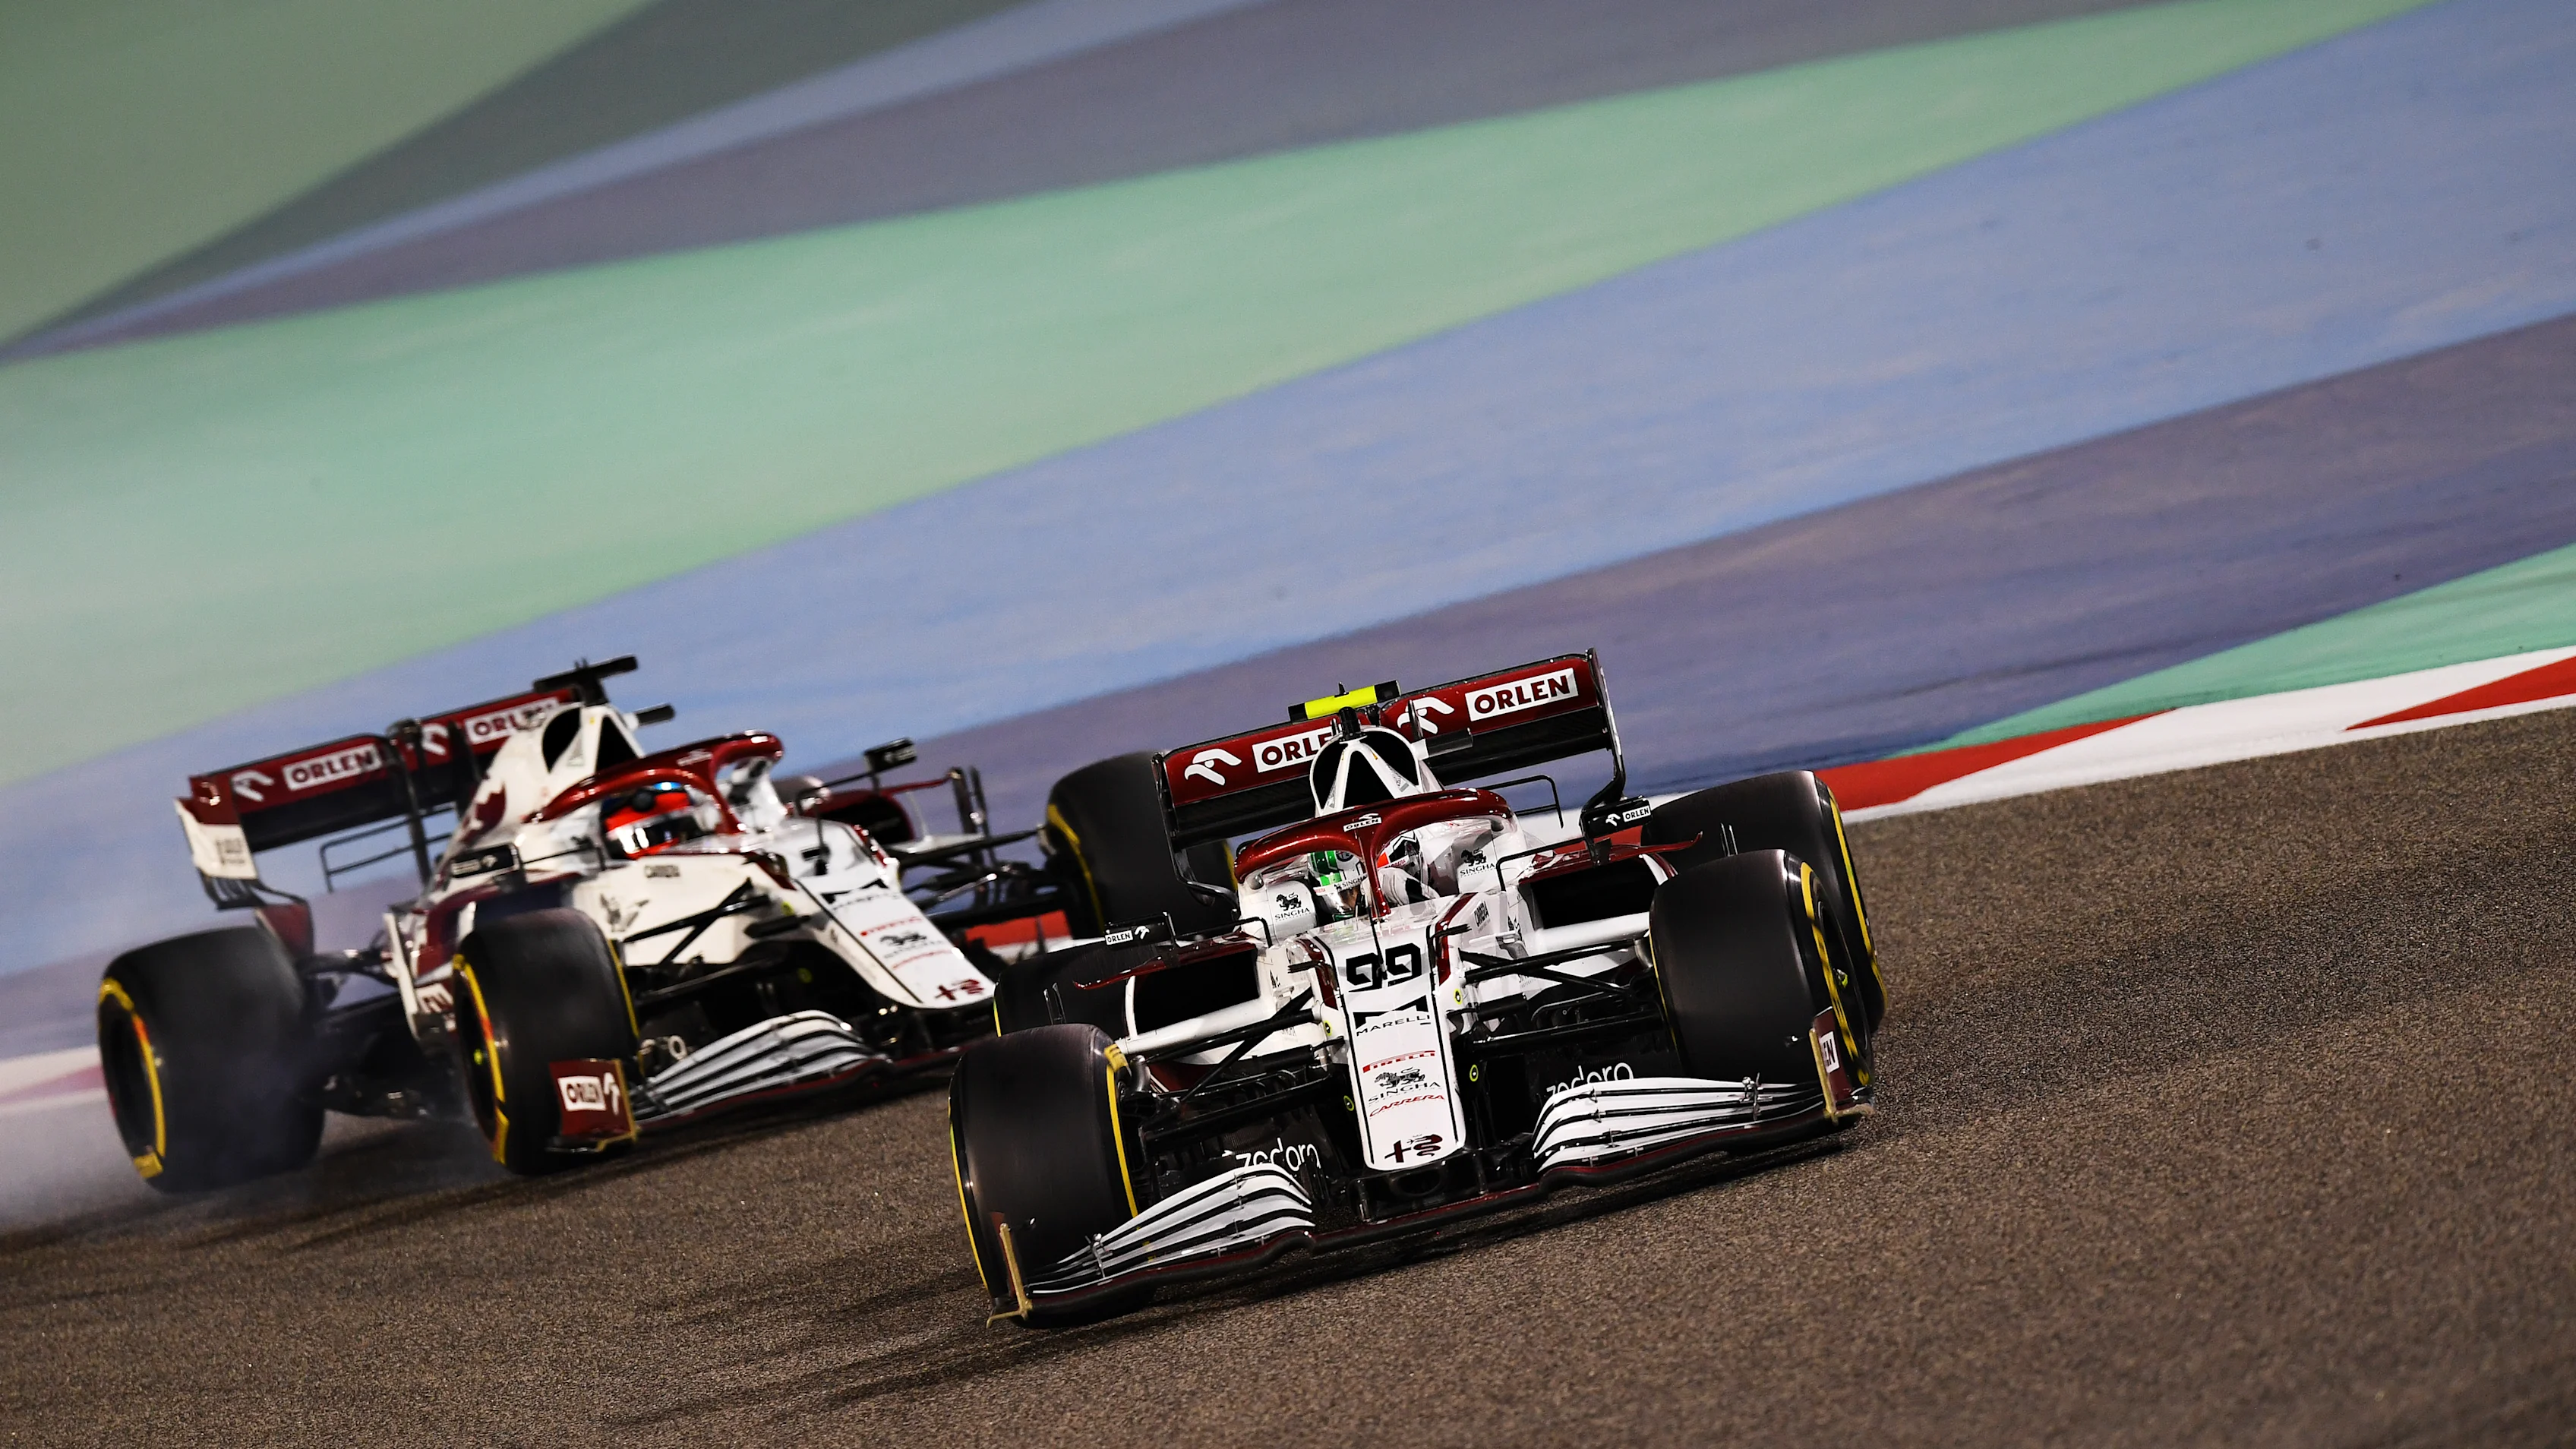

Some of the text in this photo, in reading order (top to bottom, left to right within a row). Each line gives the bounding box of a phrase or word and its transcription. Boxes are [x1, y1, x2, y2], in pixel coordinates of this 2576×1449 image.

[1474, 675, 1571, 714] ORLEN
[292, 750, 374, 782] ORLEN
[1625, 807, 1649, 819] ORLEN
[1346, 819, 1378, 829] ORLEN
[1460, 863, 1495, 875] SINGHA
[1275, 908, 1310, 919] SINGHA
[1106, 933, 1131, 943] ORLEN
[1346, 942, 1422, 993] 99
[1356, 1015, 1430, 1037] MARELLI
[1368, 1082, 1441, 1102] SINGHA
[1370, 1095, 1444, 1117] CARRERA
